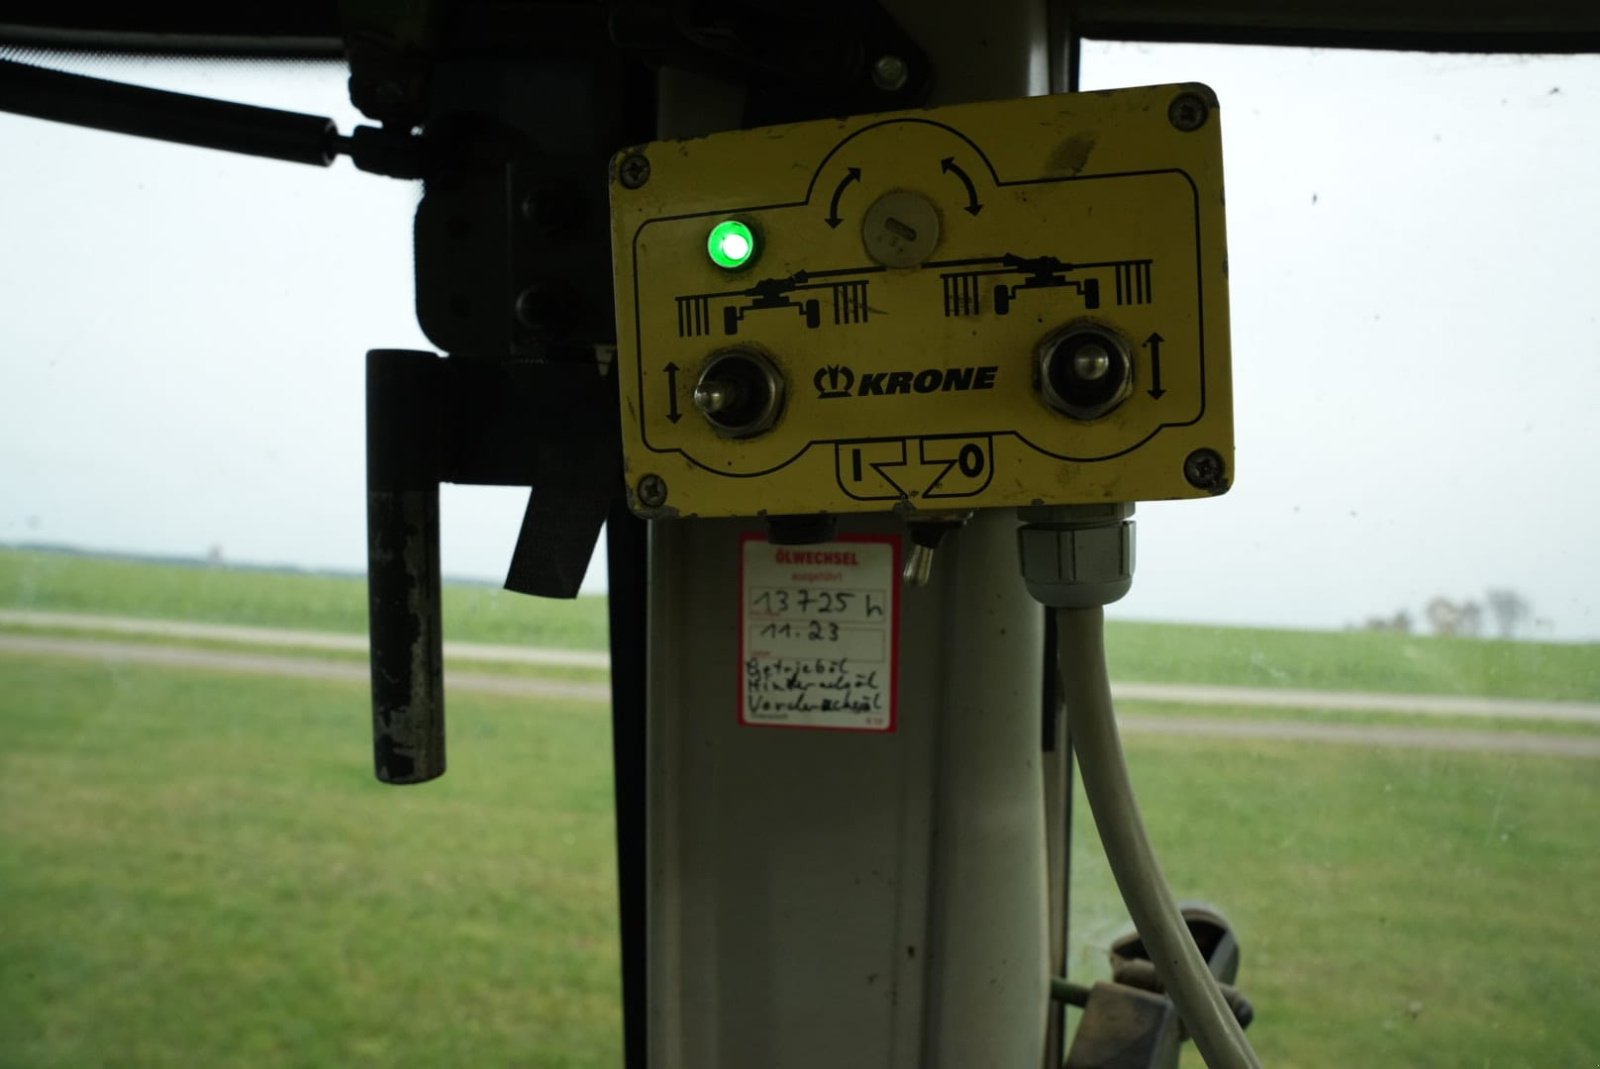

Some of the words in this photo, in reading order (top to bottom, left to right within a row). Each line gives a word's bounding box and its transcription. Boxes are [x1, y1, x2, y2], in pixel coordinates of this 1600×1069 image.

[857, 365, 999, 397] KRONE
[775, 549, 859, 565] ÖLWECHSEL
[753, 589, 856, 614] 13725
[866, 594, 883, 617] h
